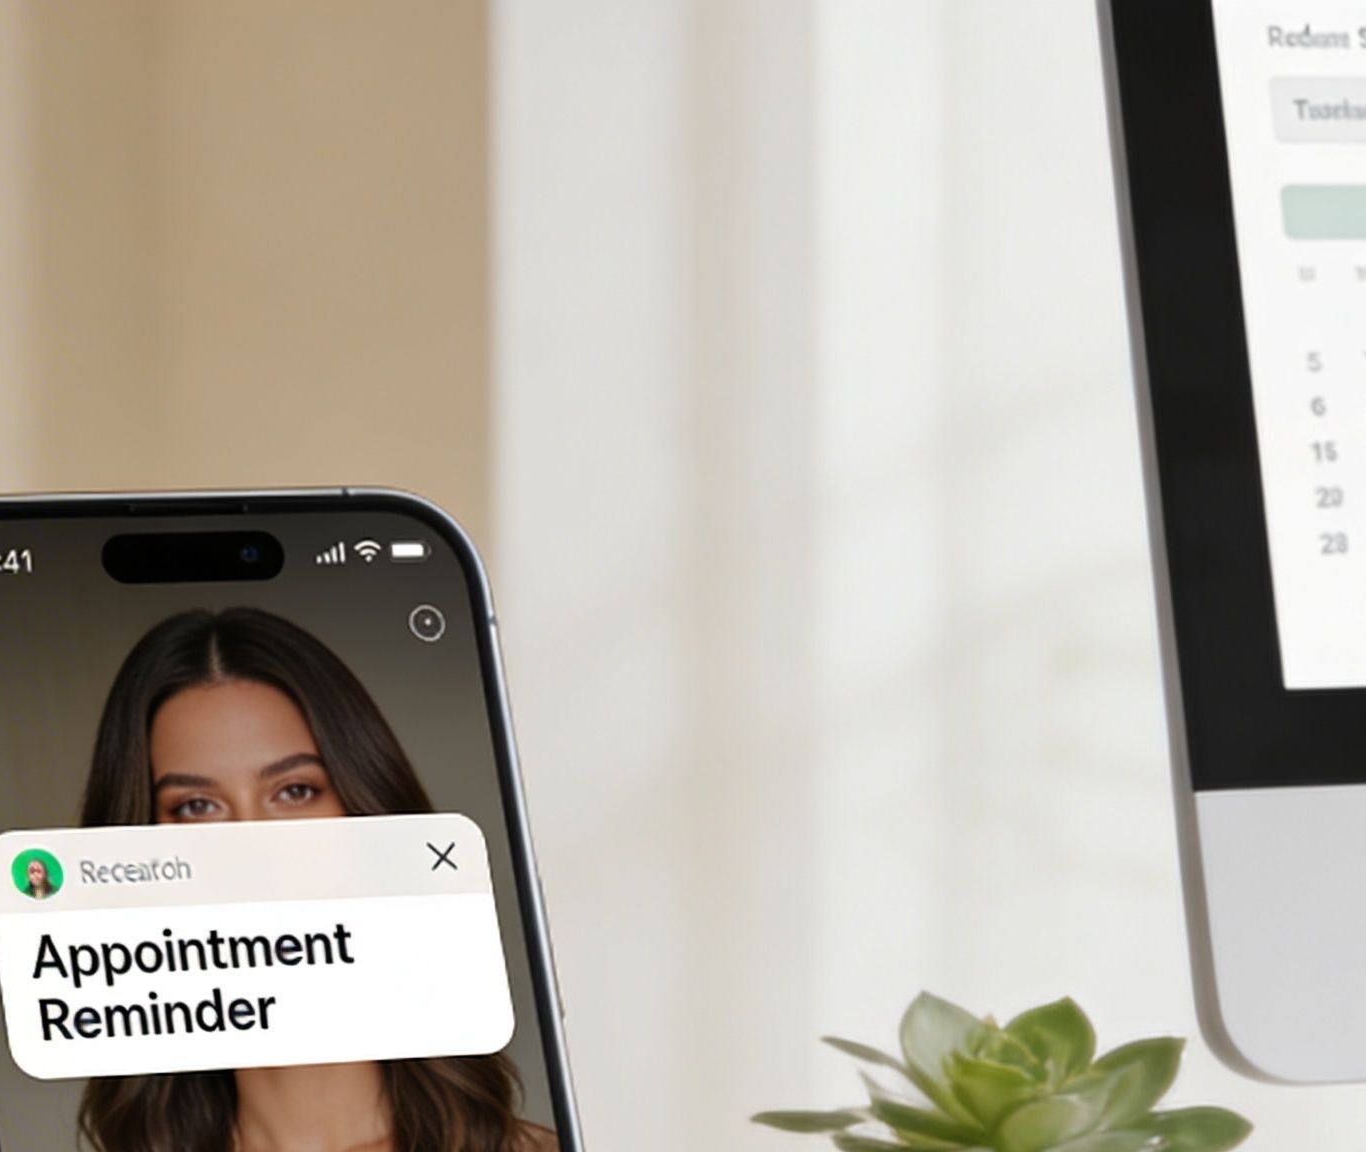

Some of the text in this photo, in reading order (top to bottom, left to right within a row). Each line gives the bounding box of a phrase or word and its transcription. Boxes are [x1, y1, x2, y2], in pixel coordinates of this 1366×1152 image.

[1306, 351, 1323, 374] 5
[32, 923, 356, 987] Appointment
[38, 988, 276, 1042] Reminder
